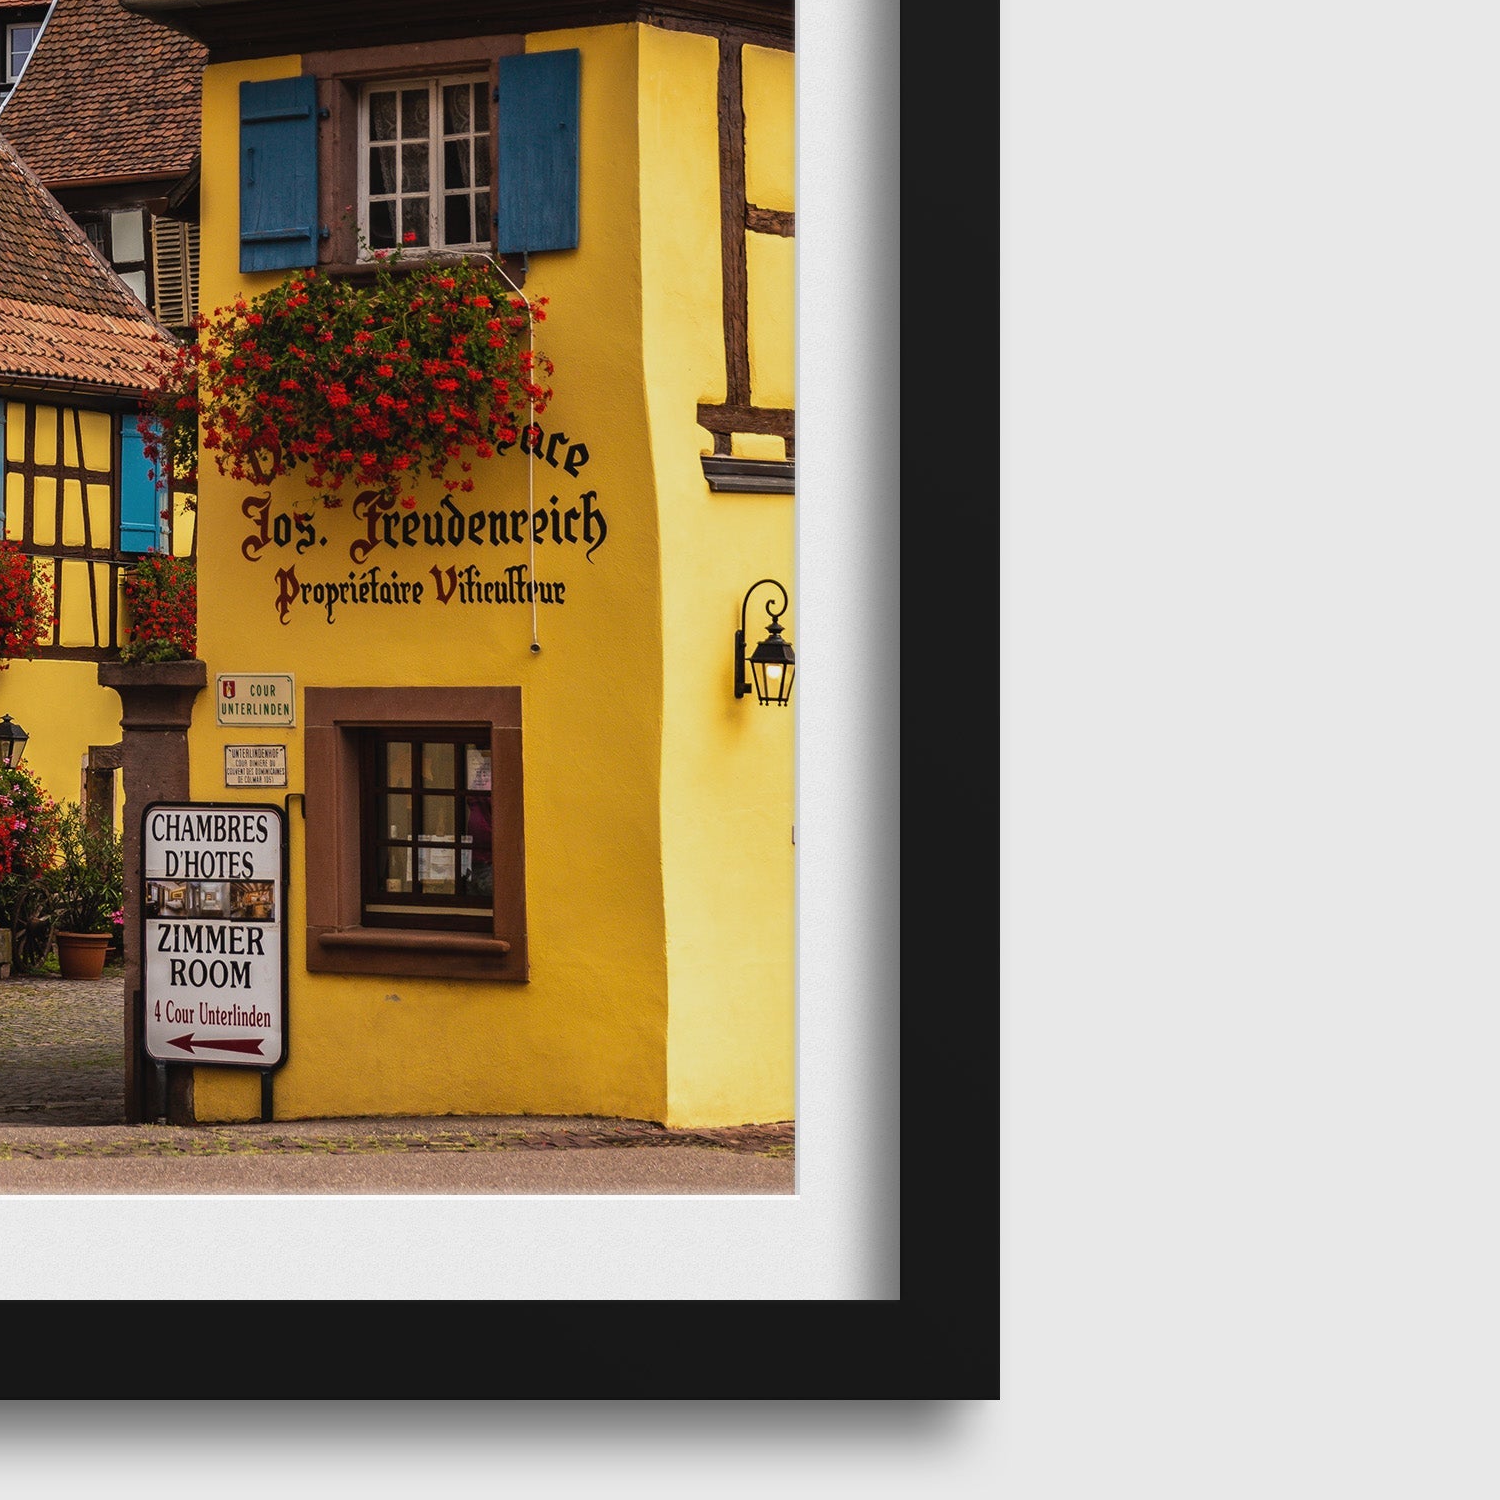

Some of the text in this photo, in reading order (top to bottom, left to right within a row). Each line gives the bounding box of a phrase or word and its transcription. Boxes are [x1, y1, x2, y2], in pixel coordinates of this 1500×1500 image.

[241, 490, 607, 564] Jos. Freudenreich
[275, 563, 566, 625] Propriétaire Viticulteur
[250, 684, 276, 697] COUR
[221, 703, 290, 716] UNTERLINDEN
[151, 813, 268, 843] CHAMBRES
[165, 850, 254, 879] D'HOTES
[157, 923, 265, 956] ZIMMER
[170, 958, 251, 989] ROOM
[154, 999, 271, 1028] 4 Cour Unterlinden
